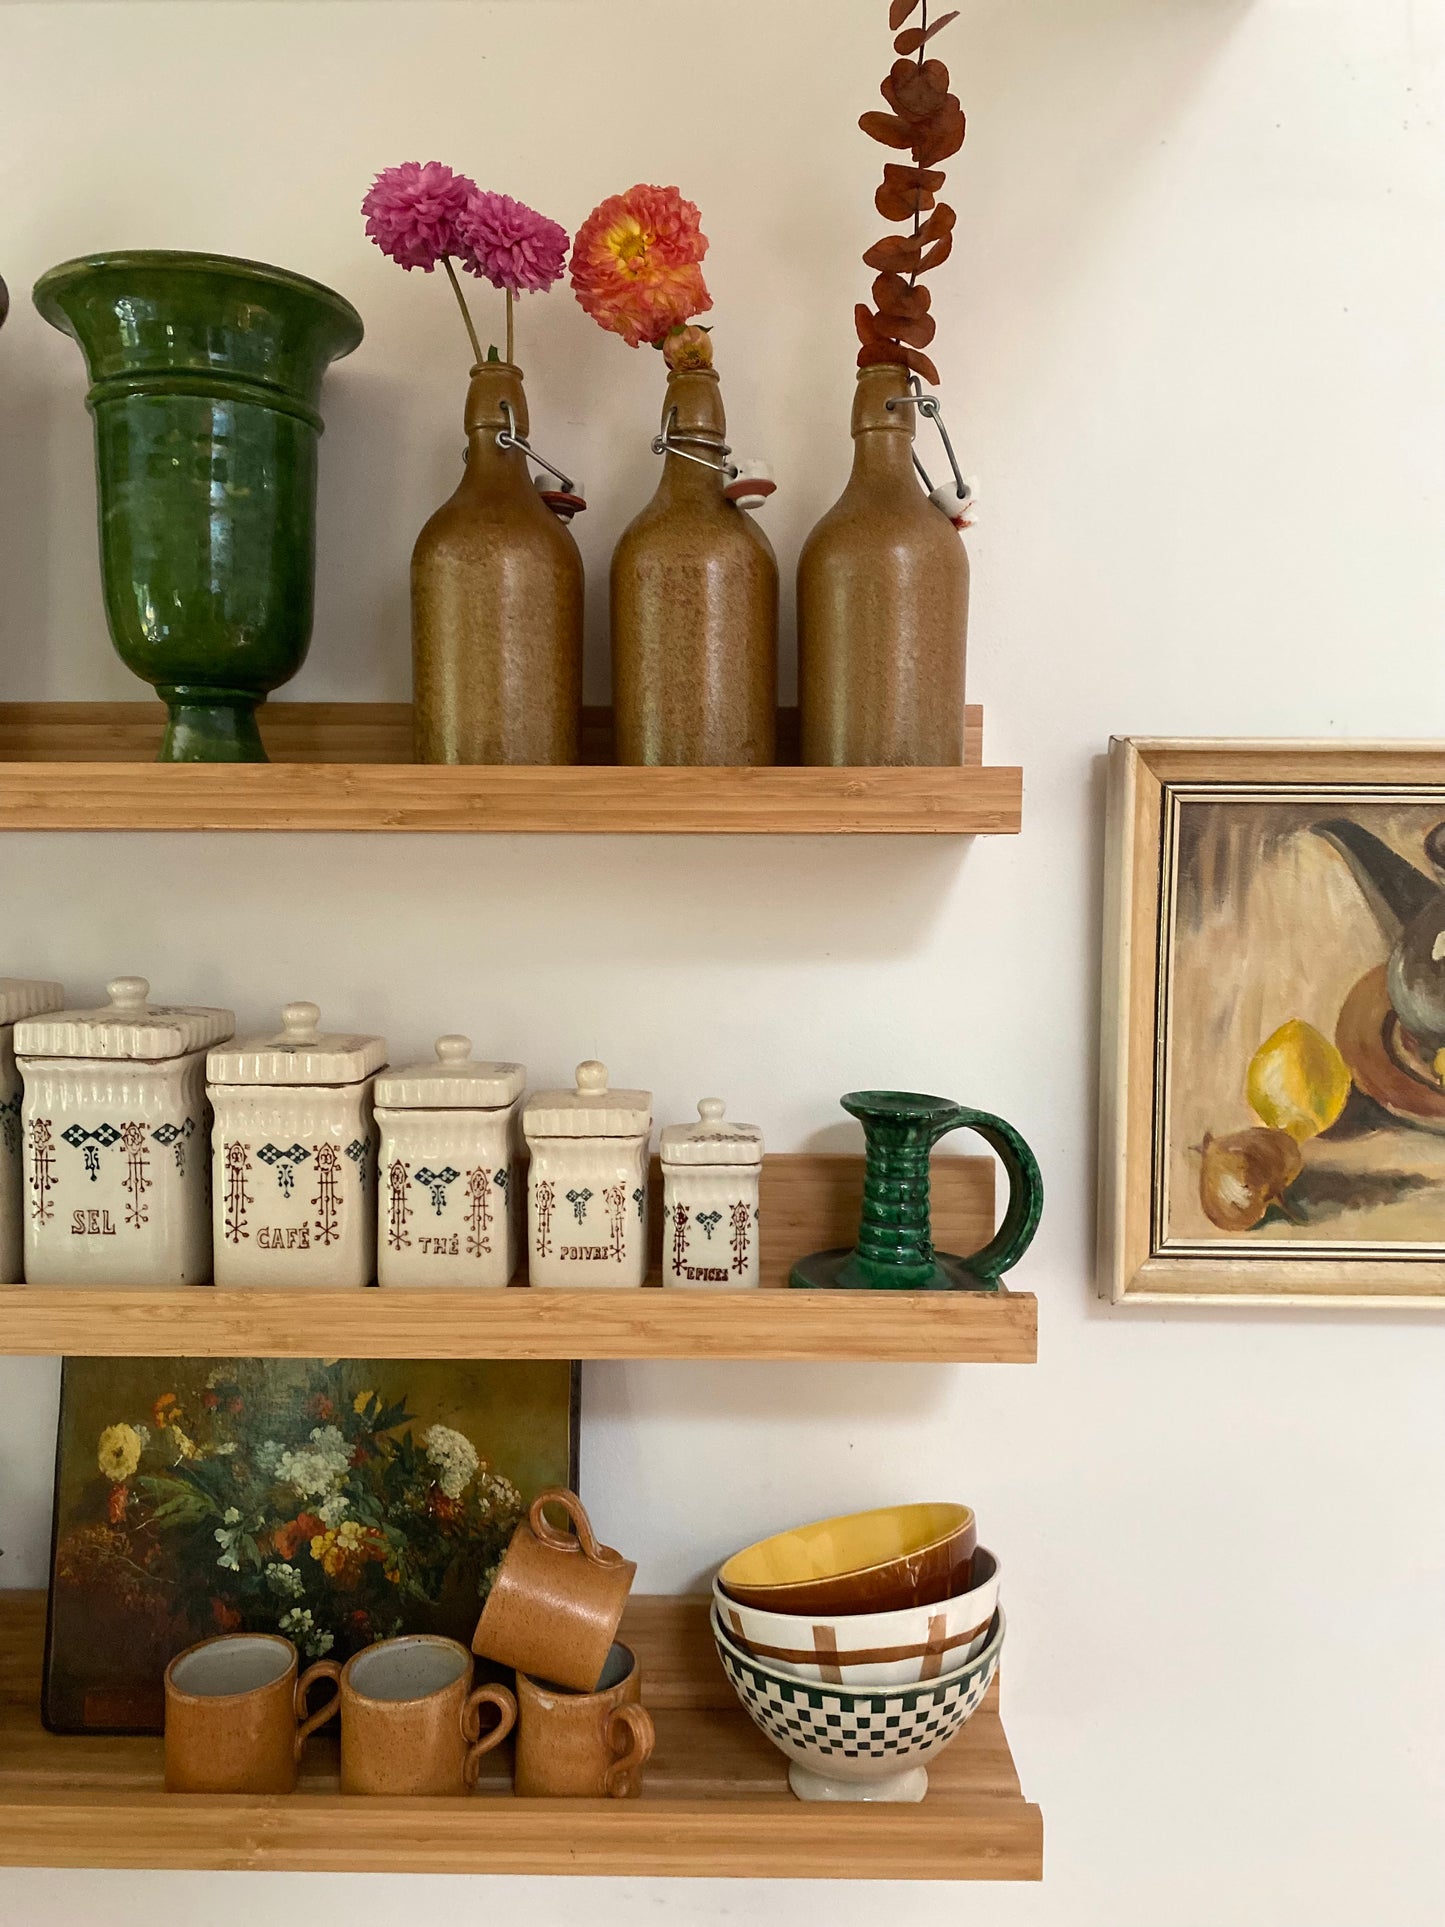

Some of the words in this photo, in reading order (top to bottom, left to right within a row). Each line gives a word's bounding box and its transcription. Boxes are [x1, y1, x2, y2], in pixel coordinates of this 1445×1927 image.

[71, 1209, 117, 1235] SEL
[256, 1221, 310, 1249] CAFÉ
[418, 1233, 459, 1255] THÉ
[560, 1246, 609, 1260] POIVRE
